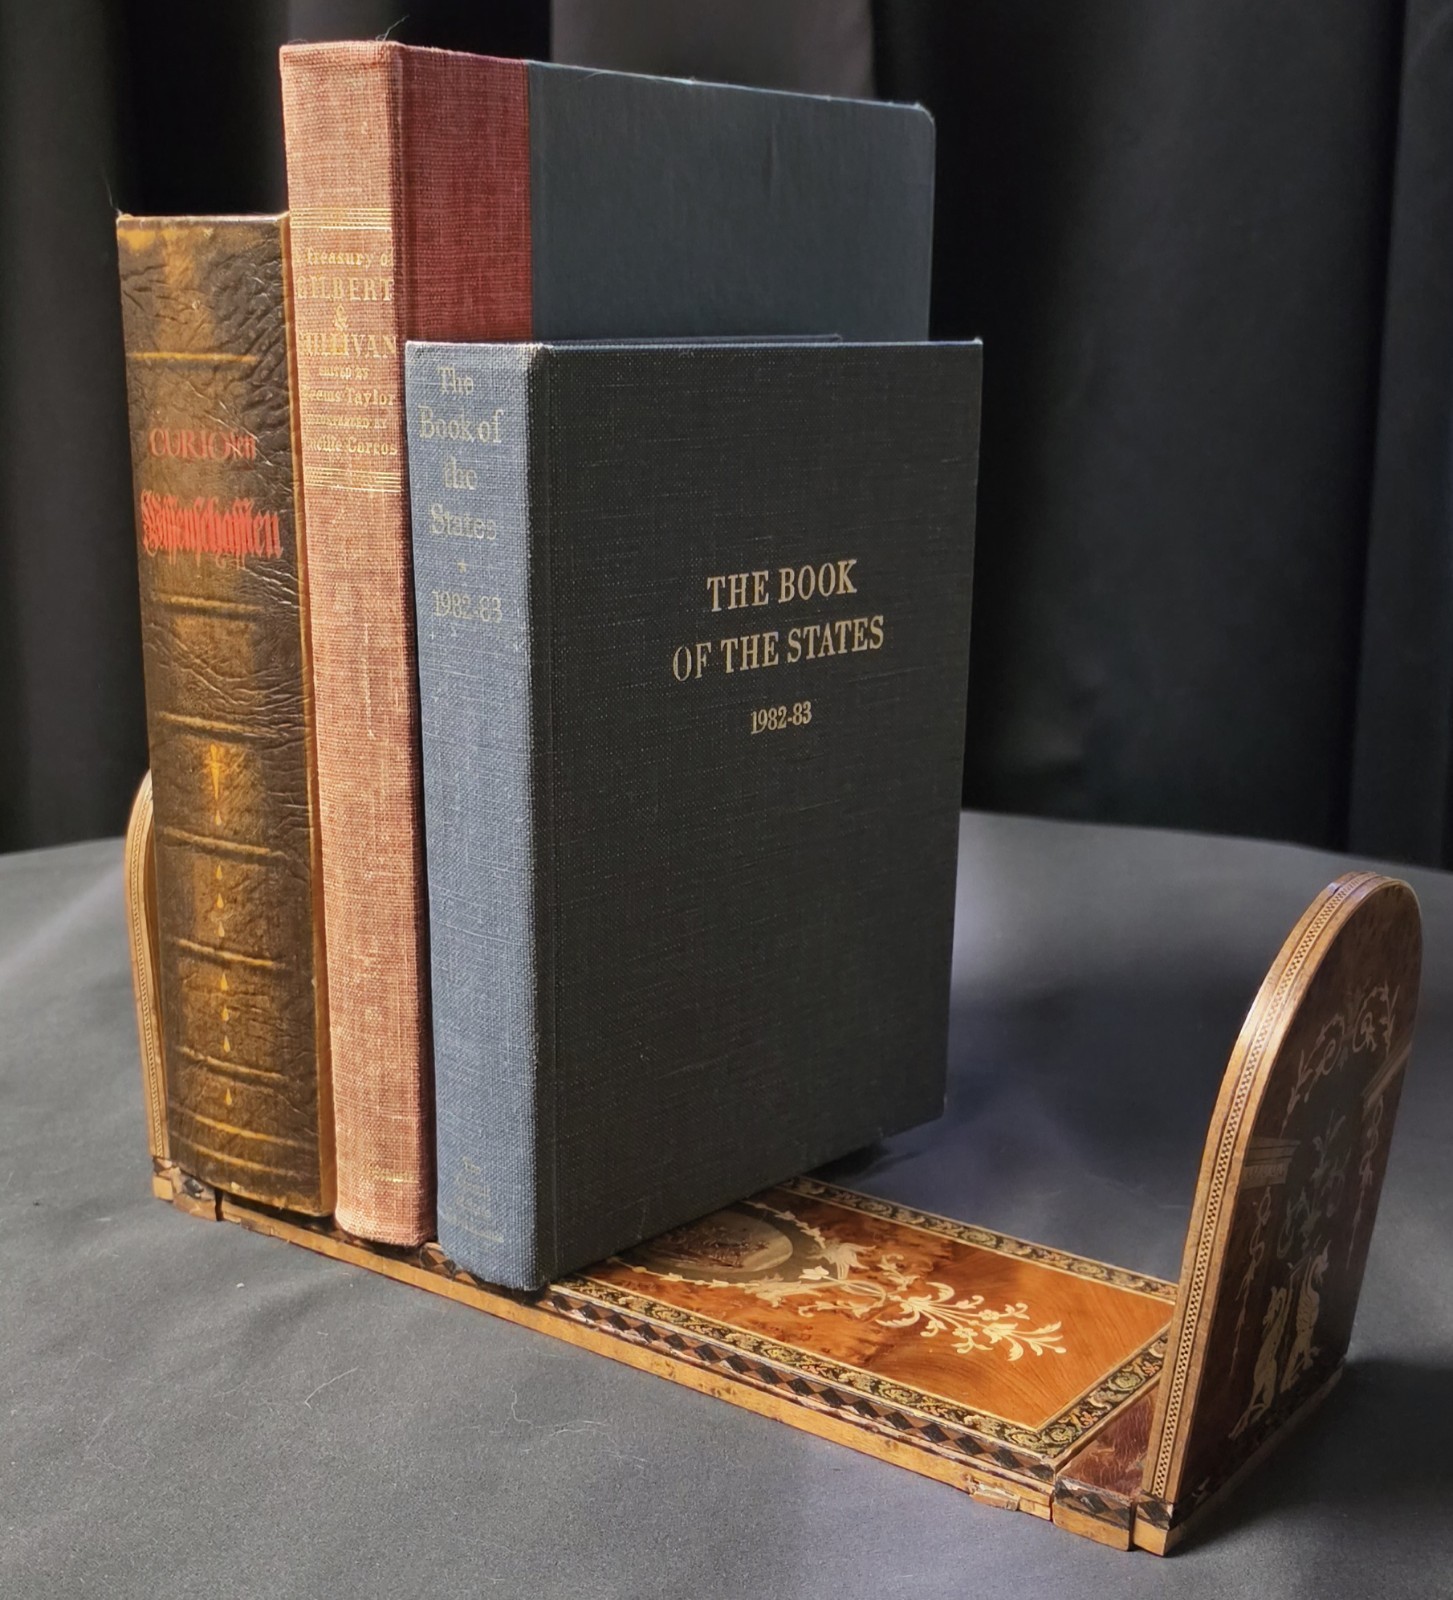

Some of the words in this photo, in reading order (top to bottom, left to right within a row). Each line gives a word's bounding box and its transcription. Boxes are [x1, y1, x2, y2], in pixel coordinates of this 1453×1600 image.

[296, 275, 395, 301] GILBERT
[332, 304, 350, 331] &
[345, 386, 397, 408] Taylor
[437, 366, 475, 396] The
[418, 405, 473, 441] Book
[478, 409, 504, 443] of
[442, 455, 478, 490] the
[430, 502, 497, 540] States
[706, 569, 770, 613] THE
[778, 558, 858, 604] BOOK
[431, 590, 503, 623] 1982-83
[672, 642, 712, 682] OF
[720, 631, 779, 674] THE
[787, 615, 885, 663] STATES
[750, 701, 813, 735] 1982-83
